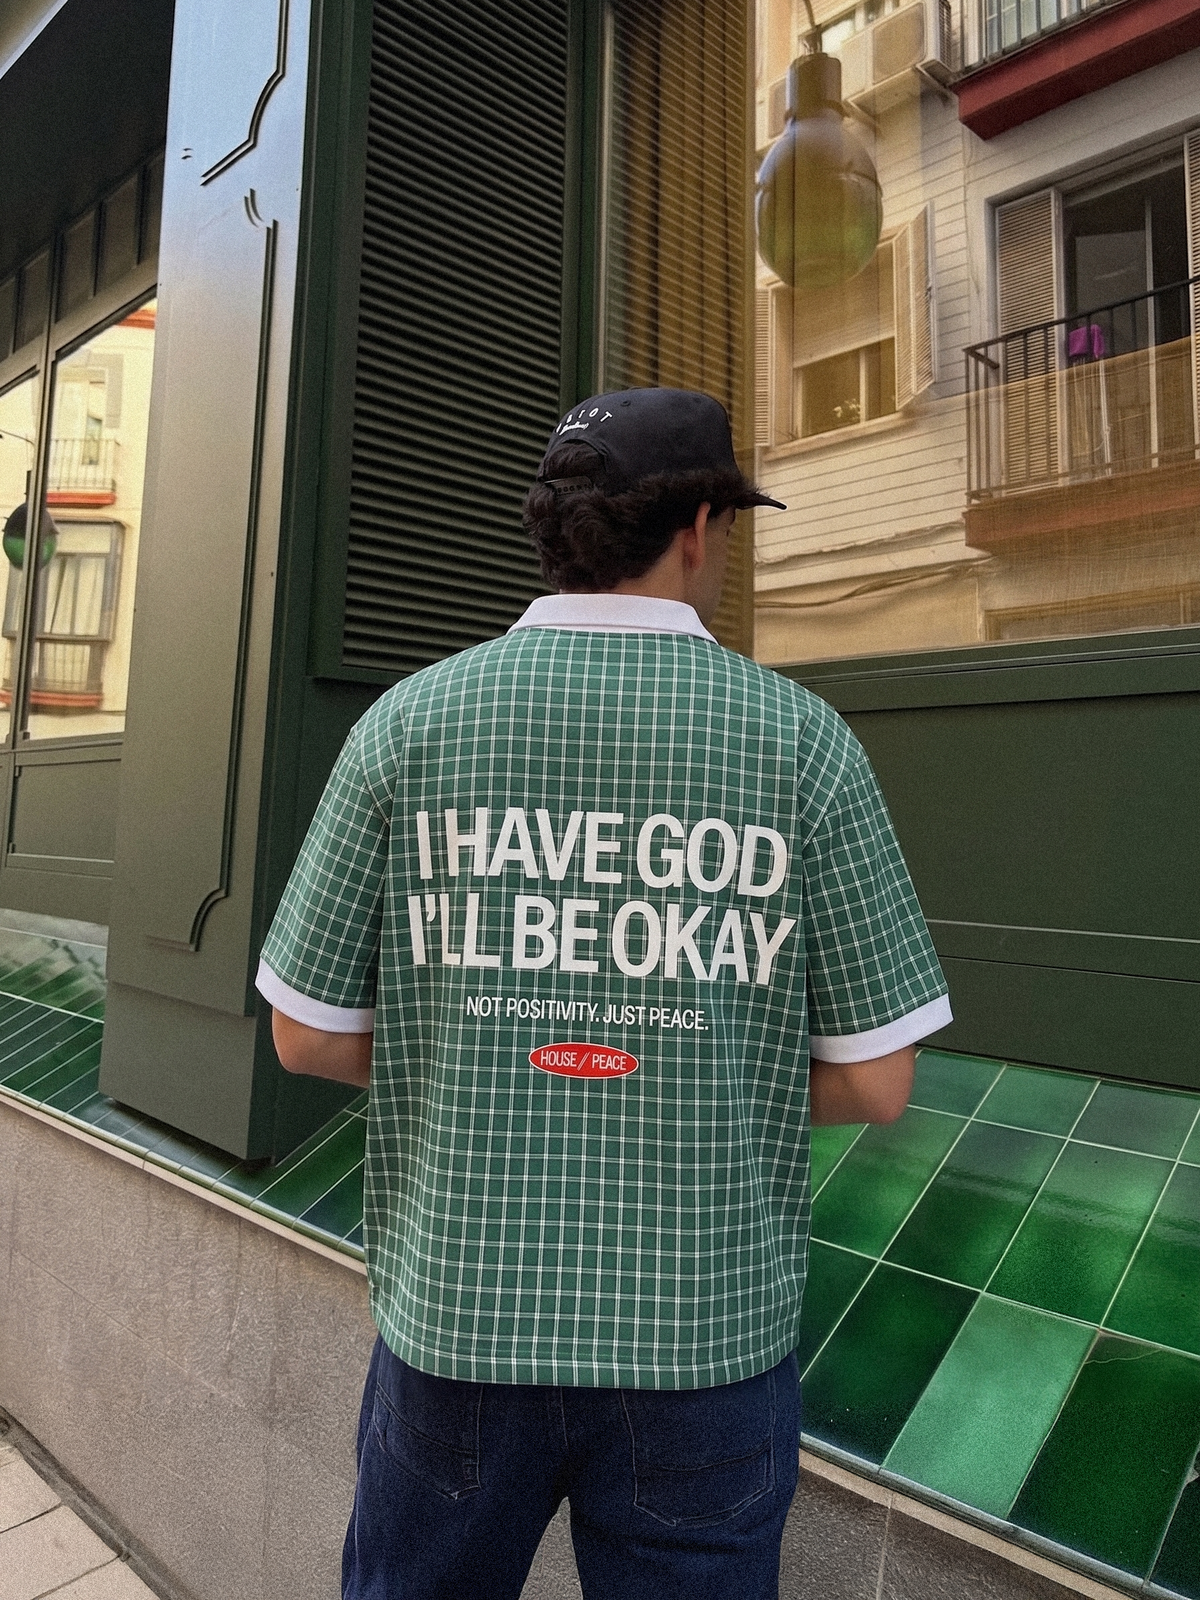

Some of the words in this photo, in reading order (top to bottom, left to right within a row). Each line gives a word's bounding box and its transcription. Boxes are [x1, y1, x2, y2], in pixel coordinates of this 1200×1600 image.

[416, 811, 433, 880] I
[444, 806, 624, 884] HAVE
[636, 813, 788, 898] GOD
[407, 892, 501, 968] I'LL
[511, 894, 600, 973] BE
[611, 900, 797, 986] OKAY
[466, 995, 503, 1017] NOT
[506, 997, 600, 1023] POSITIVITY.
[602, 1003, 646, 1026] JUST
[649, 1006, 709, 1031] PEACE.
[540, 1050, 577, 1068] HOUSE
[591, 1054, 627, 1071] PEACE
